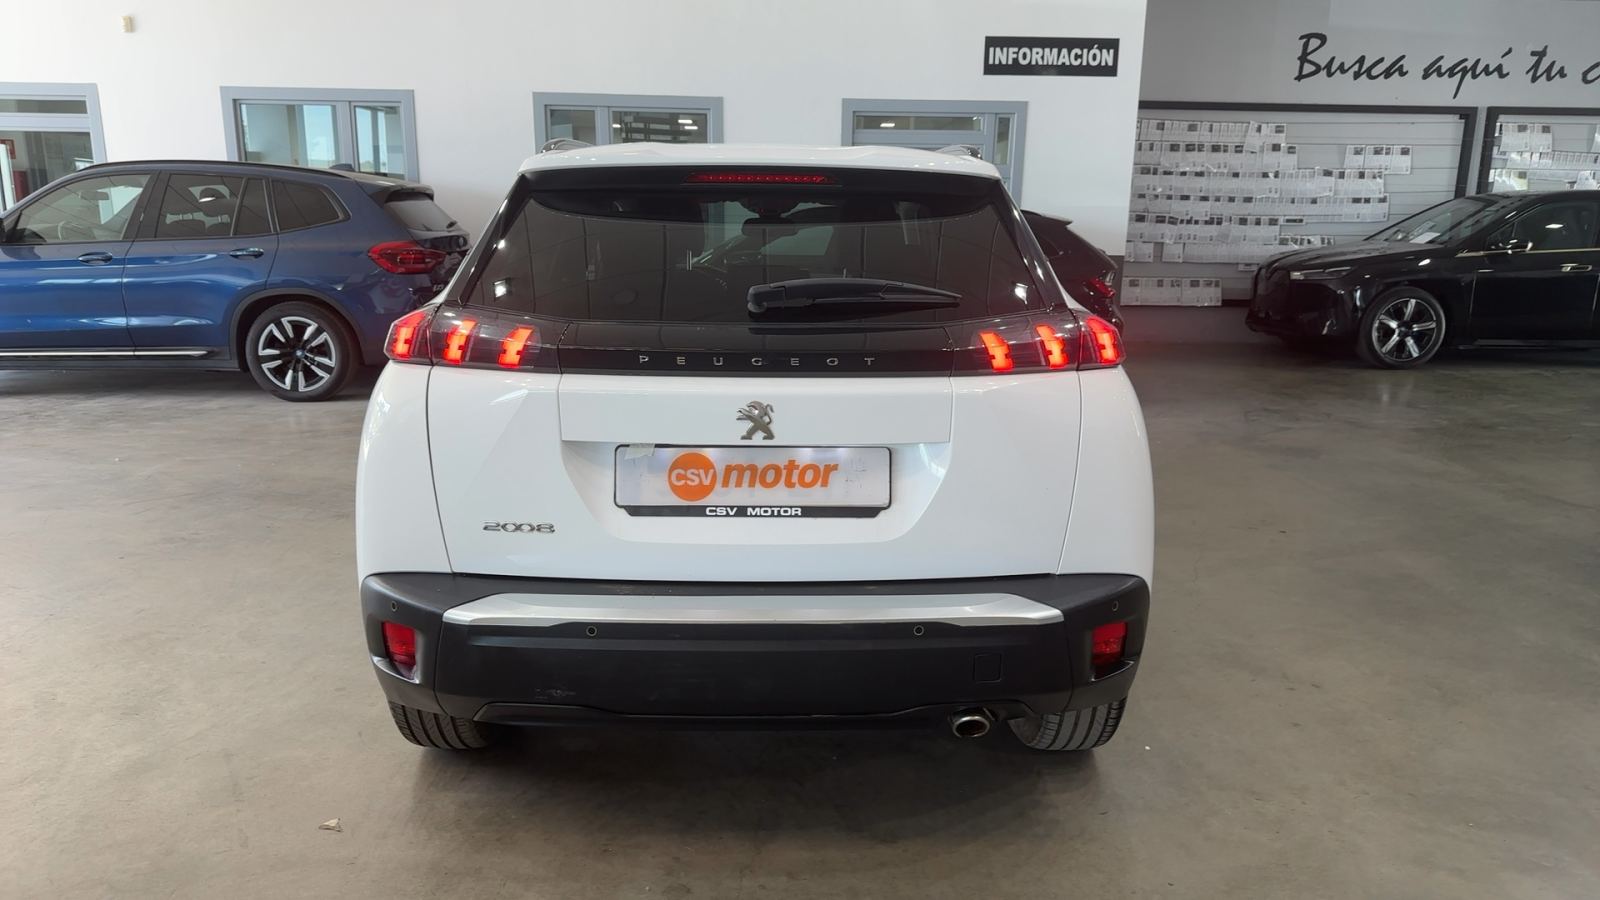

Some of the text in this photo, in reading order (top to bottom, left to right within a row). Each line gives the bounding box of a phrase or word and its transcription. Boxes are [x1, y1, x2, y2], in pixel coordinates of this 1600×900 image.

[988, 44, 1115, 67] INFORMACIÓN
[1294, 32, 1408, 82] Busca
[1422, 47, 1513, 99] aquí
[1526, 45, 1567, 83] tu
[638, 355, 877, 366] PEUGEOT
[670, 459, 838, 489] CSV motor
[705, 506, 802, 516] CSV MOTOR
[483, 521, 555, 533] 2008
